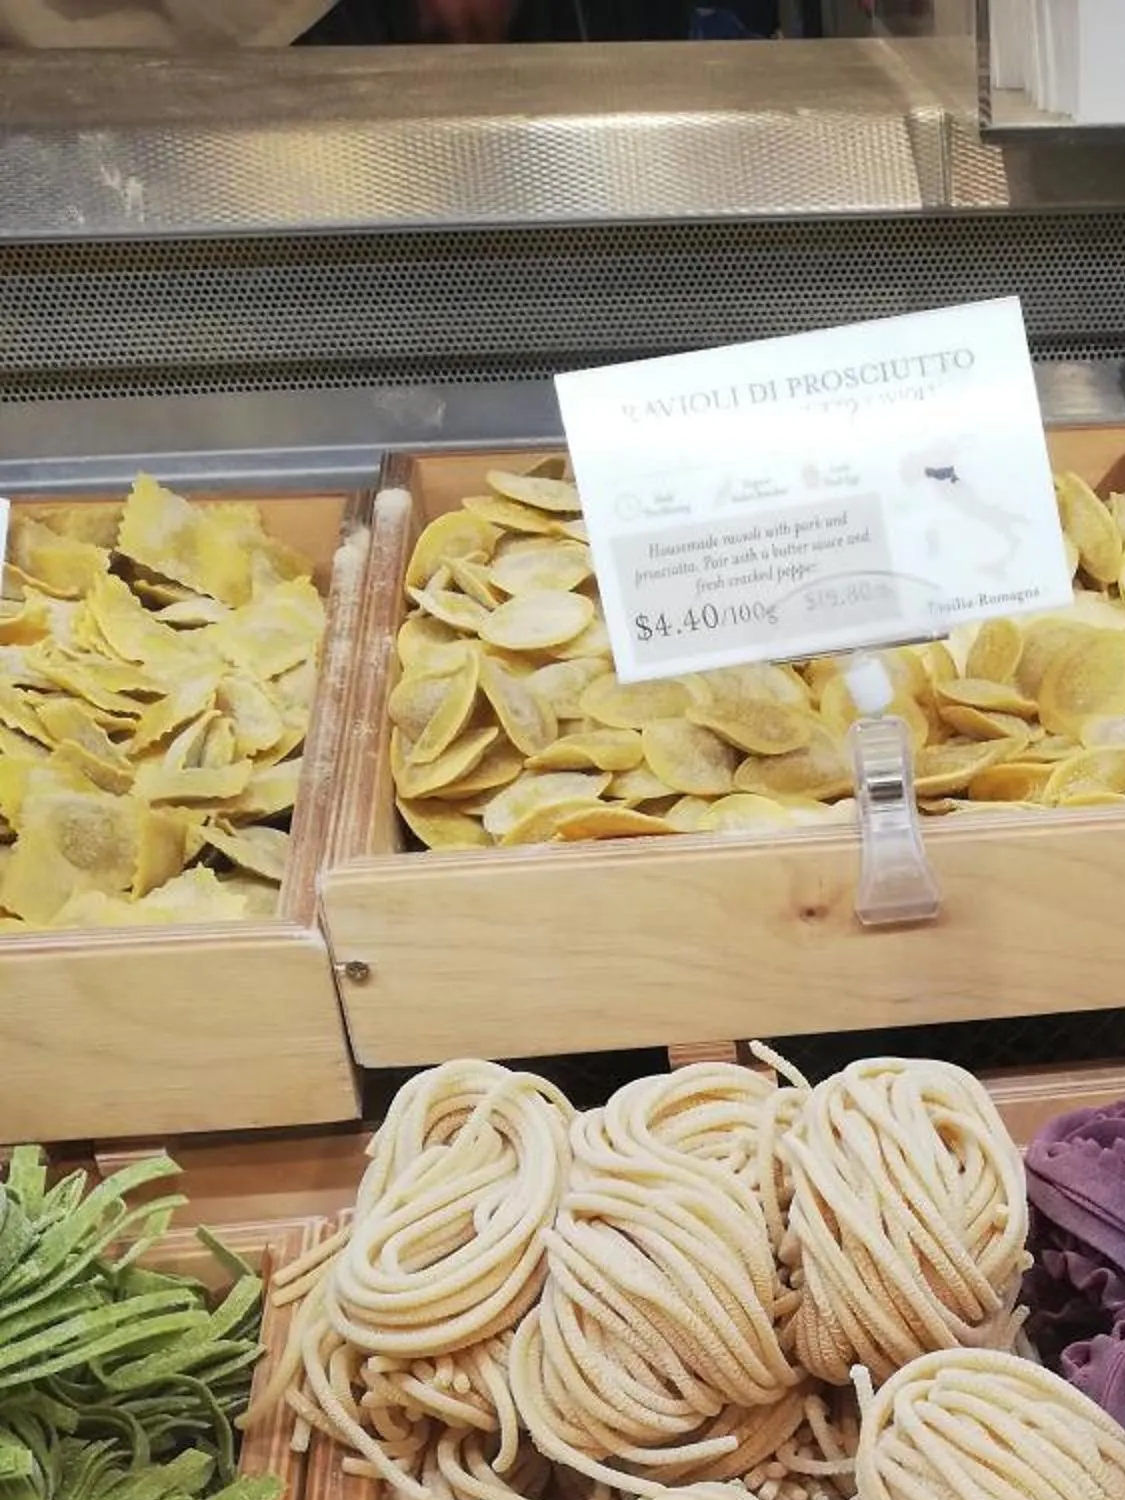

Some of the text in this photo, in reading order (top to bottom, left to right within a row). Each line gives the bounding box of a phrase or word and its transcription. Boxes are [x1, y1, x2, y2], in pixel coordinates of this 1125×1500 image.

[748, 379, 778, 405] DI
[786, 348, 976, 399] PROSCIUTTO
[634, 602, 779, 642] $4.40/100g
